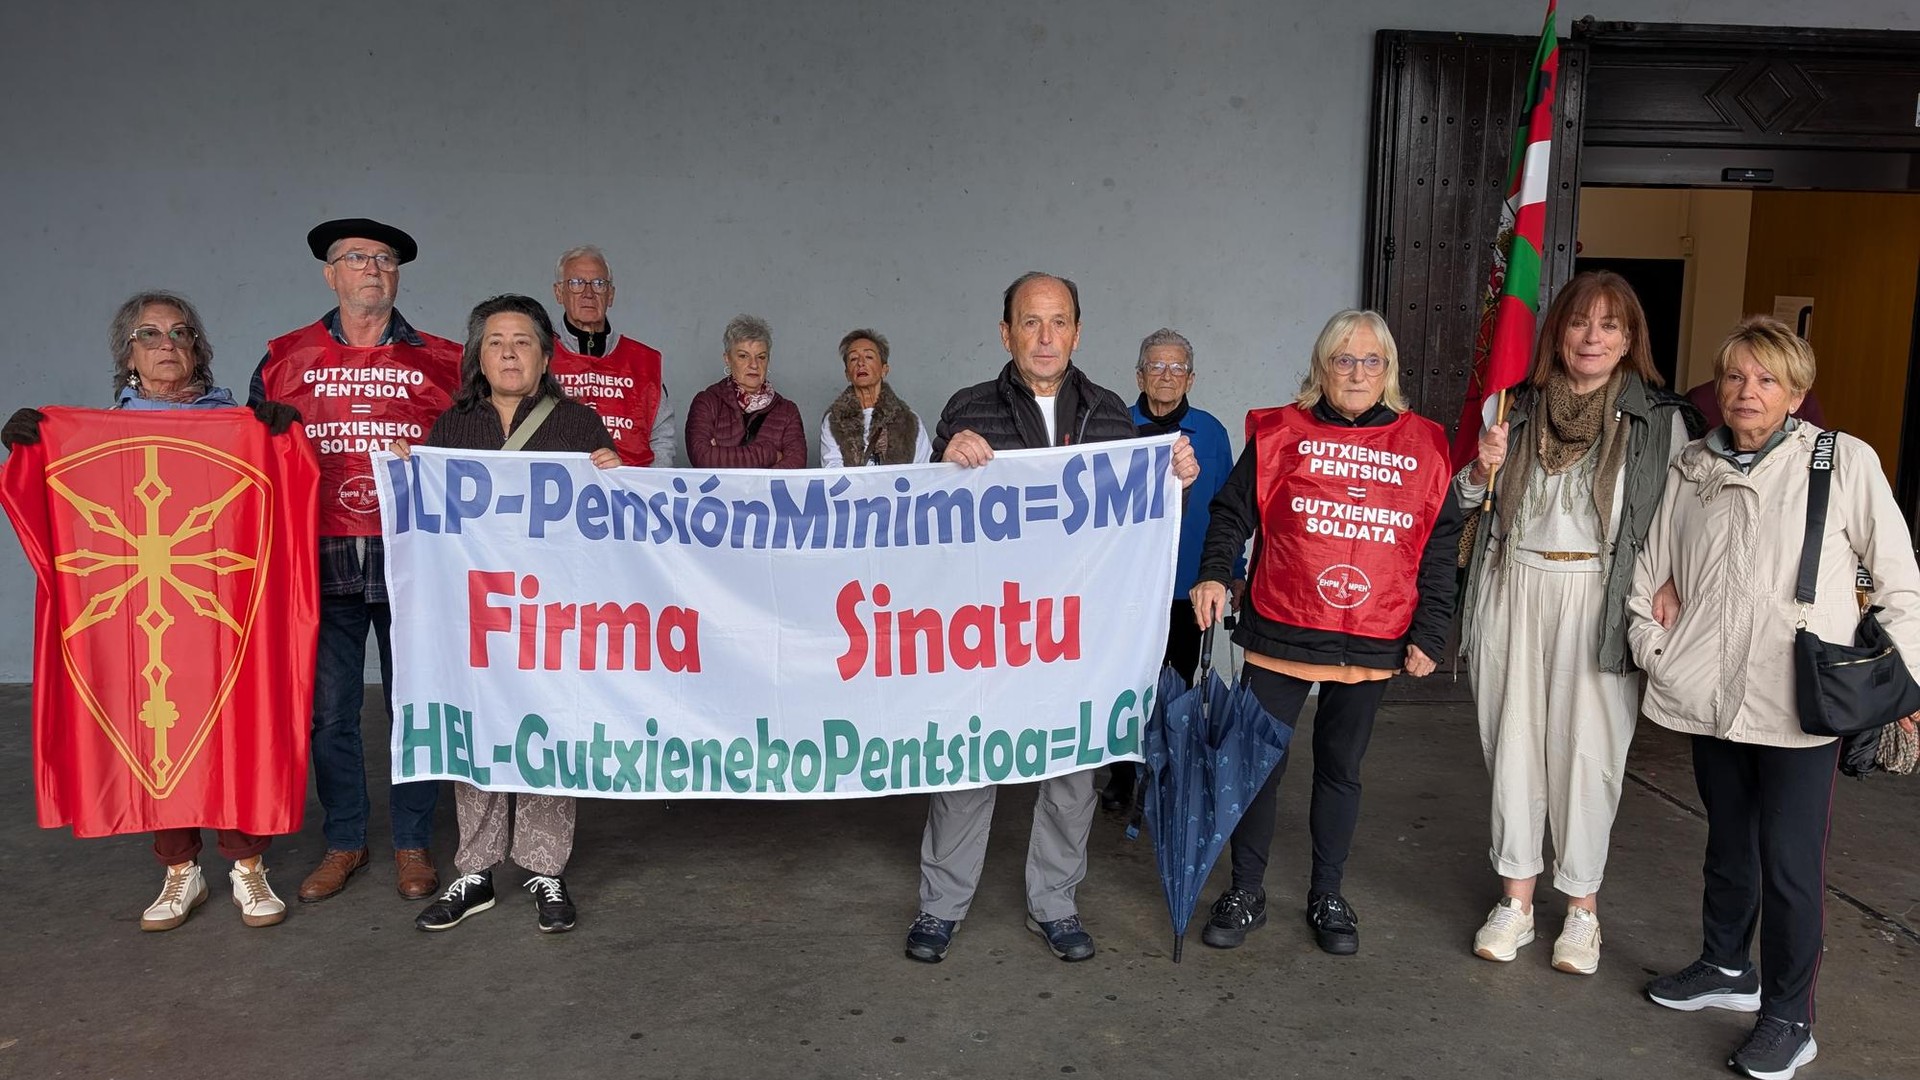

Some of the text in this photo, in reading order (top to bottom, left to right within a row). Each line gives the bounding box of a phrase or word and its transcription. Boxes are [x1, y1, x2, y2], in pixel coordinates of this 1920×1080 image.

[303, 367, 424, 385] GUTXIENEKO
[555, 372, 634, 388] UTXIENEKO
[314, 383, 409, 399] PENTSIOA
[561, 385, 625, 399] ENTSIOA
[304, 421, 422, 438] GUTXIENEKO
[320, 438, 397, 454] SOLDAT
[1297, 440, 1418, 471] GUTXIENEKO
[1309, 458, 1403, 486] PENTSIOA
[340, 489, 360, 498] EHPM
[1291, 497, 1413, 529] GUTXIENEKO
[1306, 518, 1396, 544] SOLDATA
[1319, 578, 1368, 592] EHPM MPEH
[467, 570, 1081, 682] Firma Sinatu
